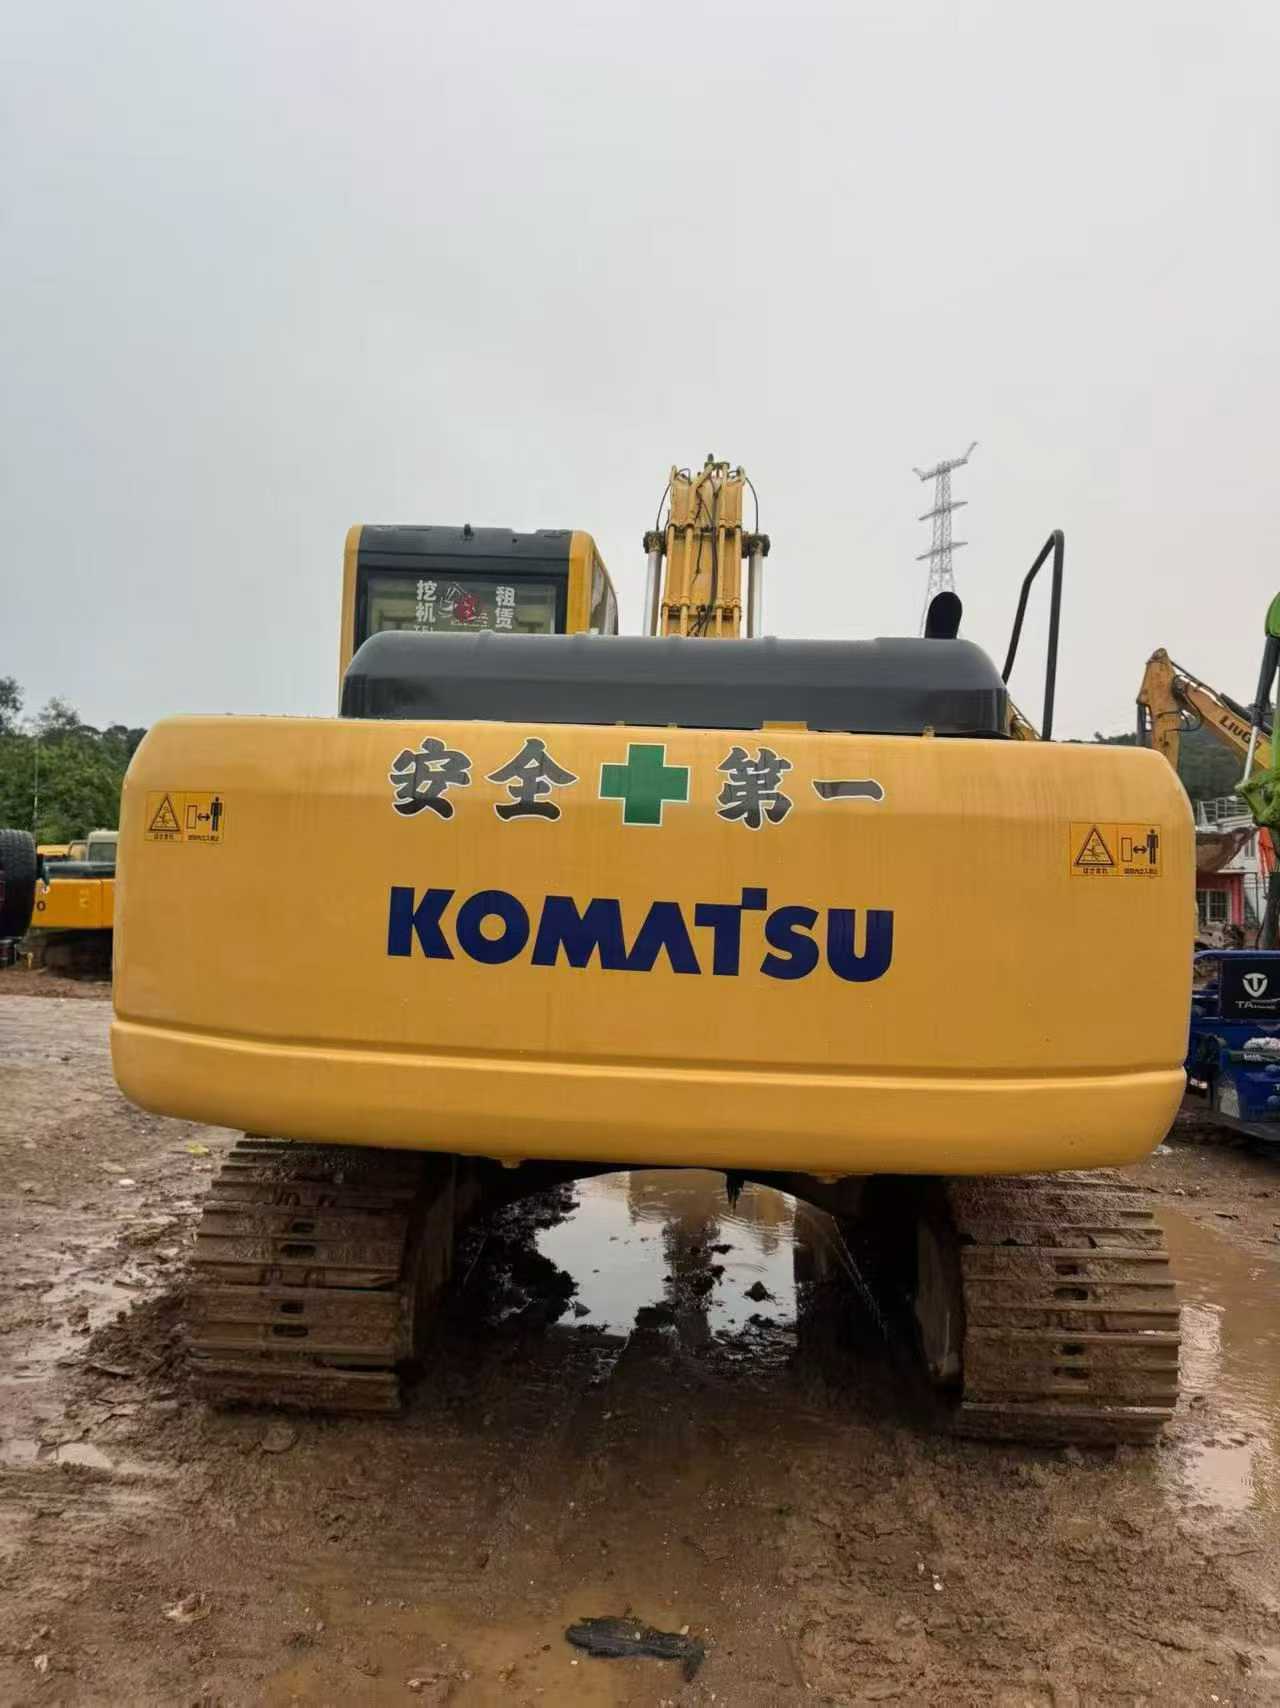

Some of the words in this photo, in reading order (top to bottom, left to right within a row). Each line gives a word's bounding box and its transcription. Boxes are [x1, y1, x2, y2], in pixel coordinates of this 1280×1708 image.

[415, 579, 438, 623] 挖机
[495, 585, 516, 630] 租赁
[388, 736, 580, 822] 安全
[716, 745, 886, 830] 第一
[387, 886, 895, 983] KOMATSU
